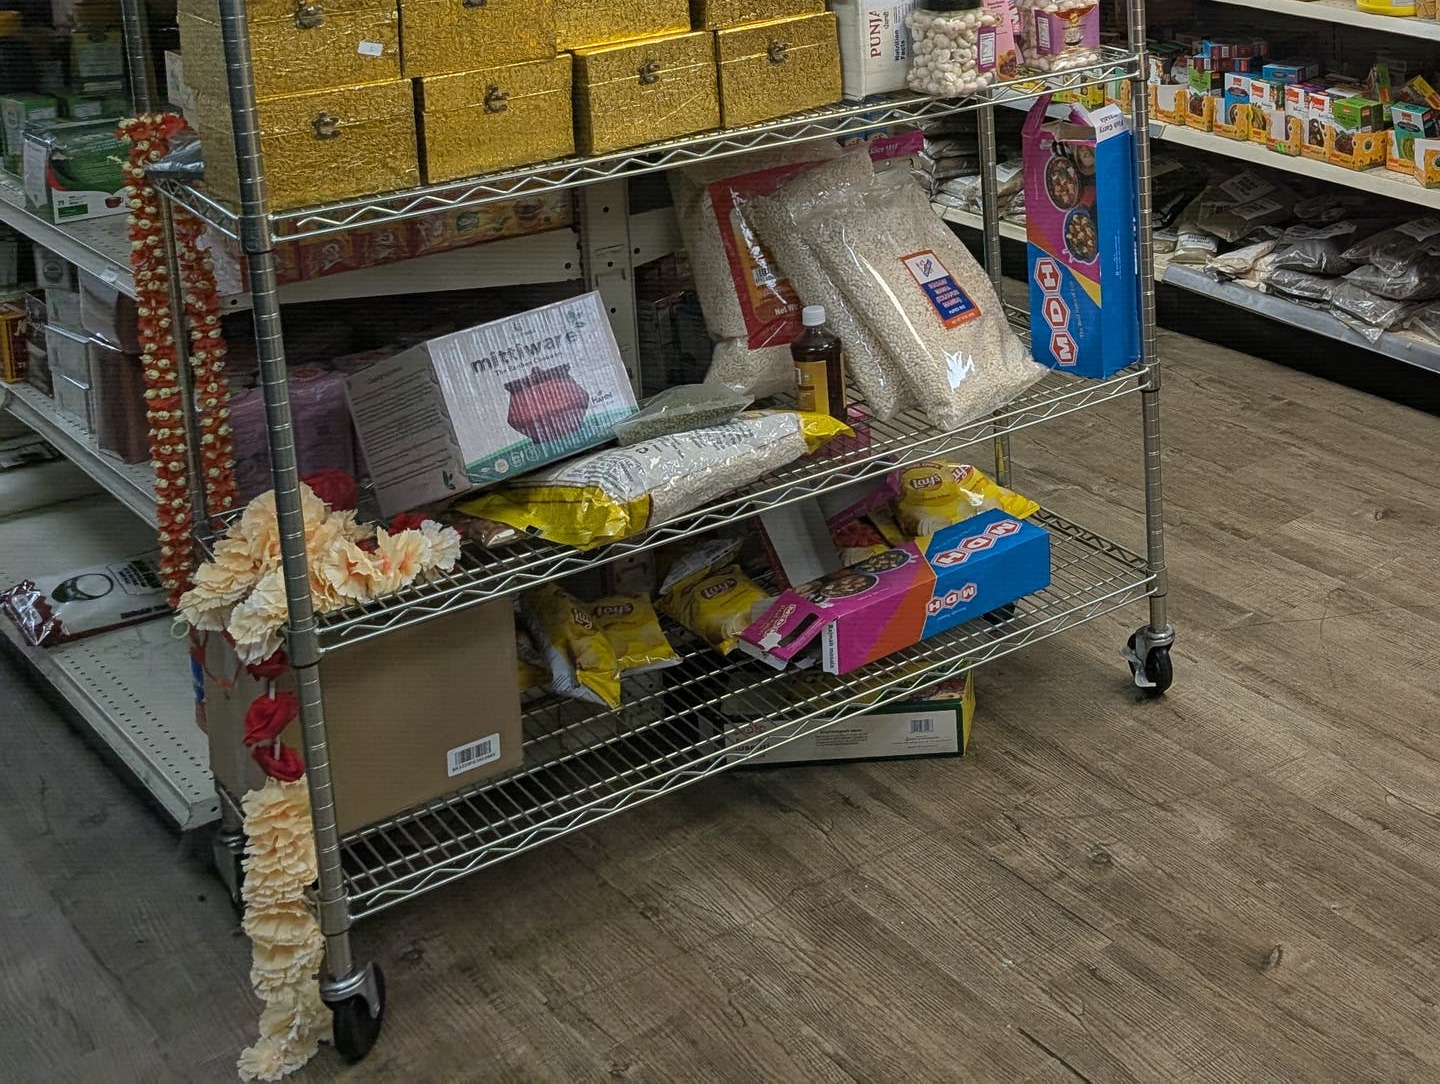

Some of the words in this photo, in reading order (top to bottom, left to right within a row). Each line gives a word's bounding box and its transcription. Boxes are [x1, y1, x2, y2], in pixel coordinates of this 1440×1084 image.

[893, 29, 901, 61] Nutrition
[1099, 123, 1113, 134] Curry
[1113, 119, 1124, 128] Fish
[1037, 260, 1076, 363] MDH
[470, 330, 579, 376] mittiware
[912, 474, 943, 491] Lay's
[933, 518, 1020, 565] MDH
[703, 578, 738, 599] Lay's
[928, 582, 977, 615] MDH
[827, 624, 836, 647] Rajmah
[828, 647, 836, 669] masala
